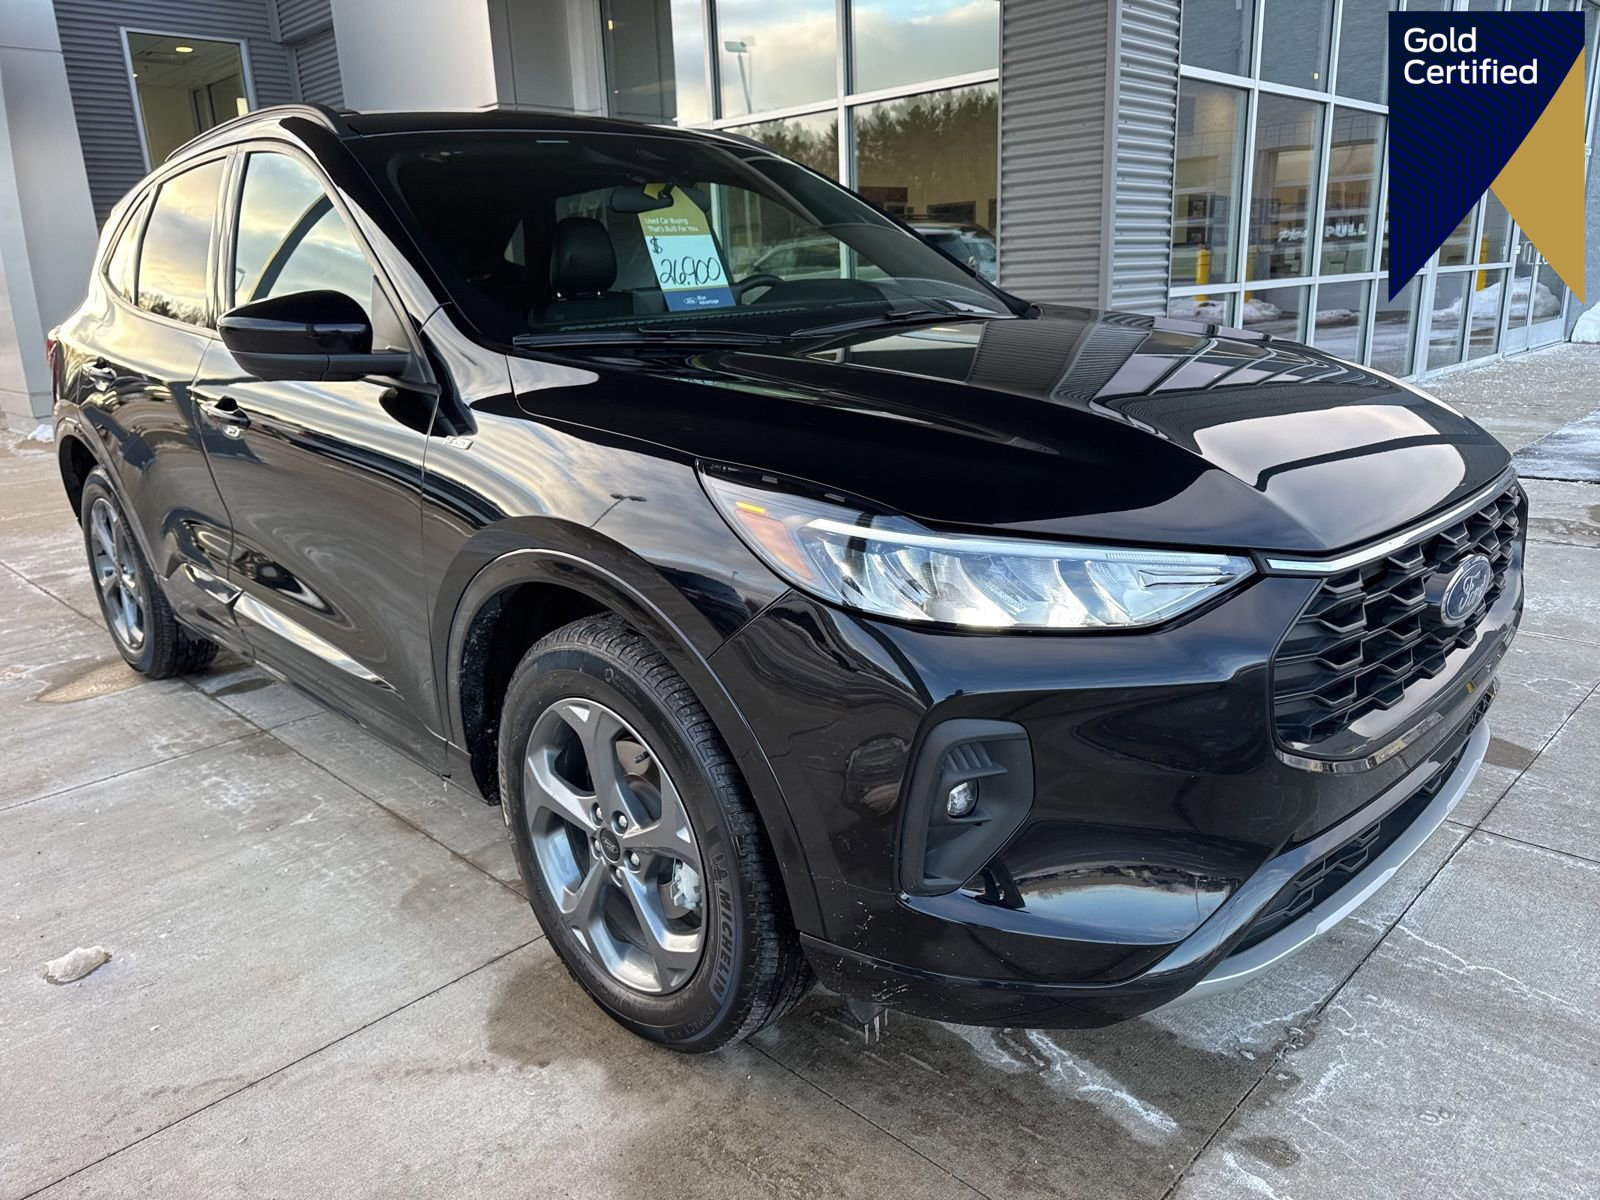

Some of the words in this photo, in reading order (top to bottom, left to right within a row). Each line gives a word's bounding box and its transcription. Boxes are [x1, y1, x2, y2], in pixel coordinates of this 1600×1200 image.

[645, 217, 659, 225] Used
[659, 217, 669, 225] Car
[669, 217, 688, 226] Buying
[1325, 223, 1367, 238] PULL
[650, 236, 663, 255] $
[1458, 570, 1488, 613] Ford
[712, 887, 734, 1000] MICHELIN
